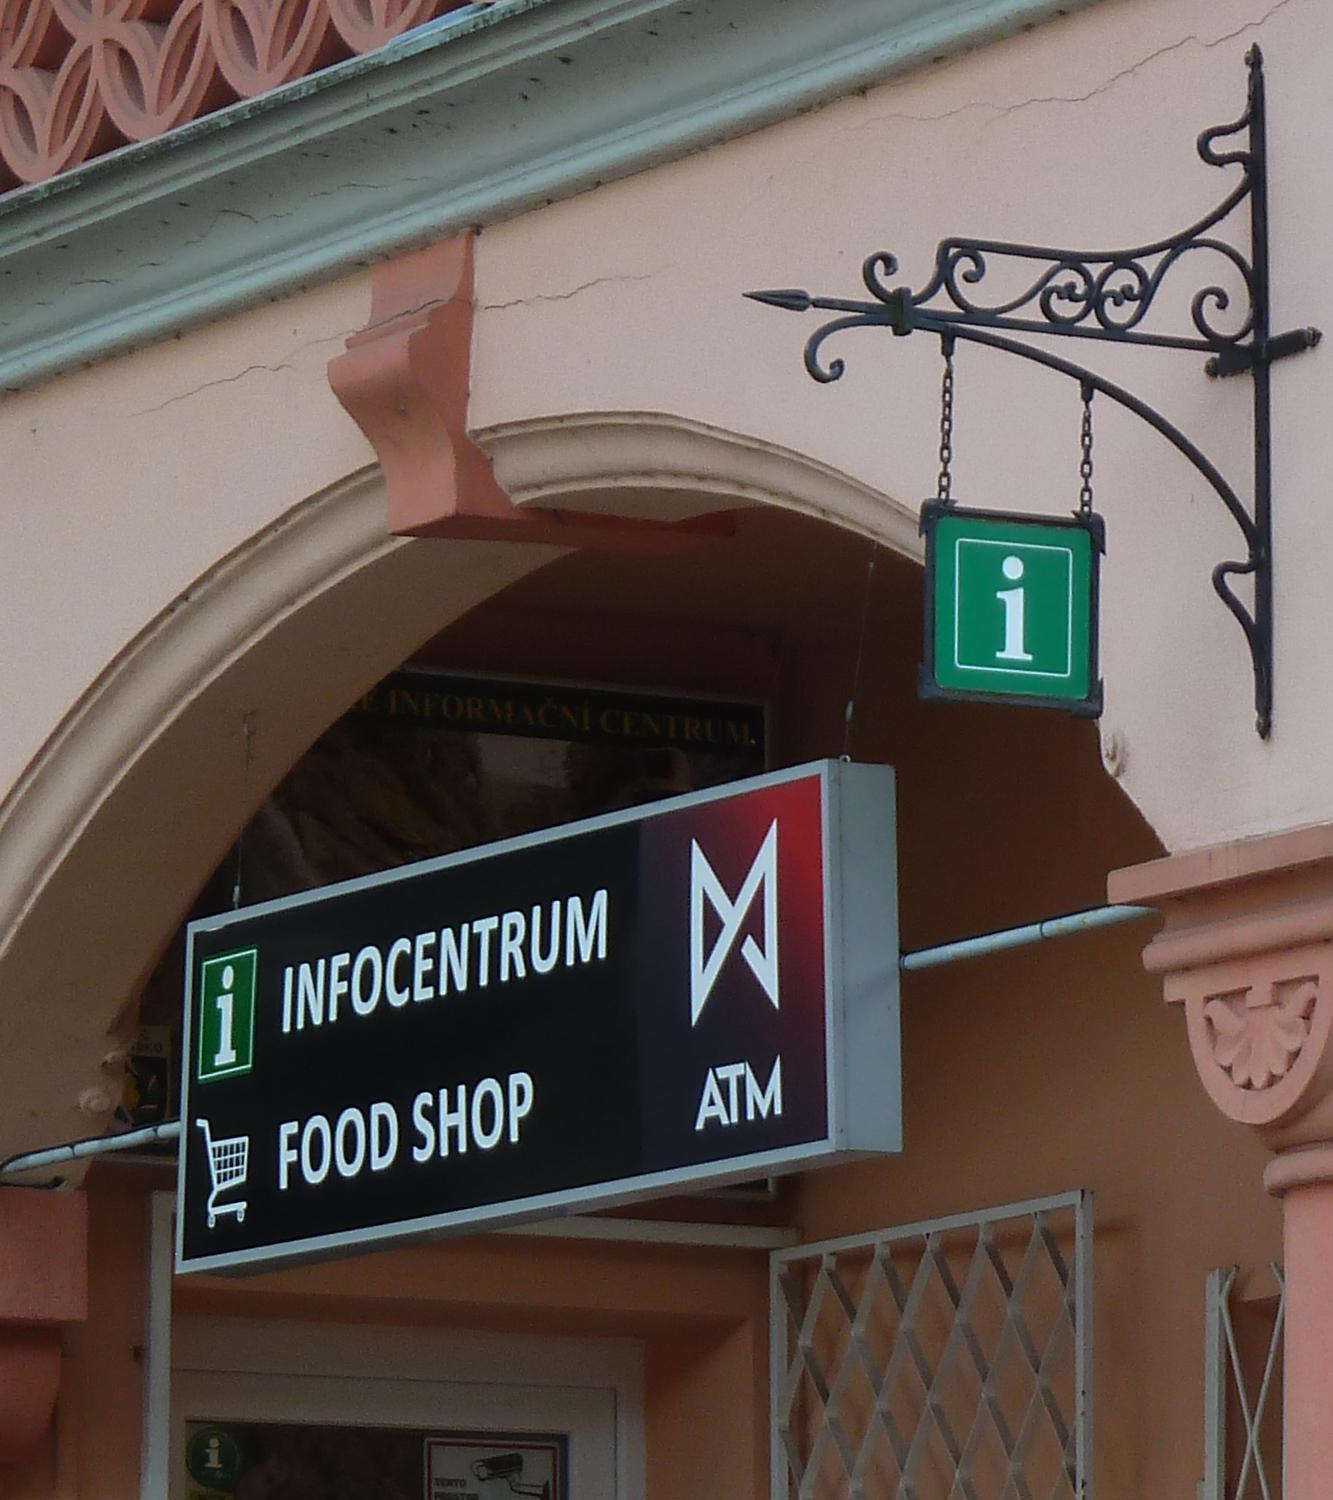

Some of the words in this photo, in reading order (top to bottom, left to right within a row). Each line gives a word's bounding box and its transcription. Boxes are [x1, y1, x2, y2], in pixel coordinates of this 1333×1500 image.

[600, 709, 752, 745] CENTRUM
[281, 888, 609, 1033] INFOCENTRUM
[278, 1102, 399, 1191] FOOD
[411, 1071, 535, 1163] SHOP
[695, 1054, 783, 1131] ATM
